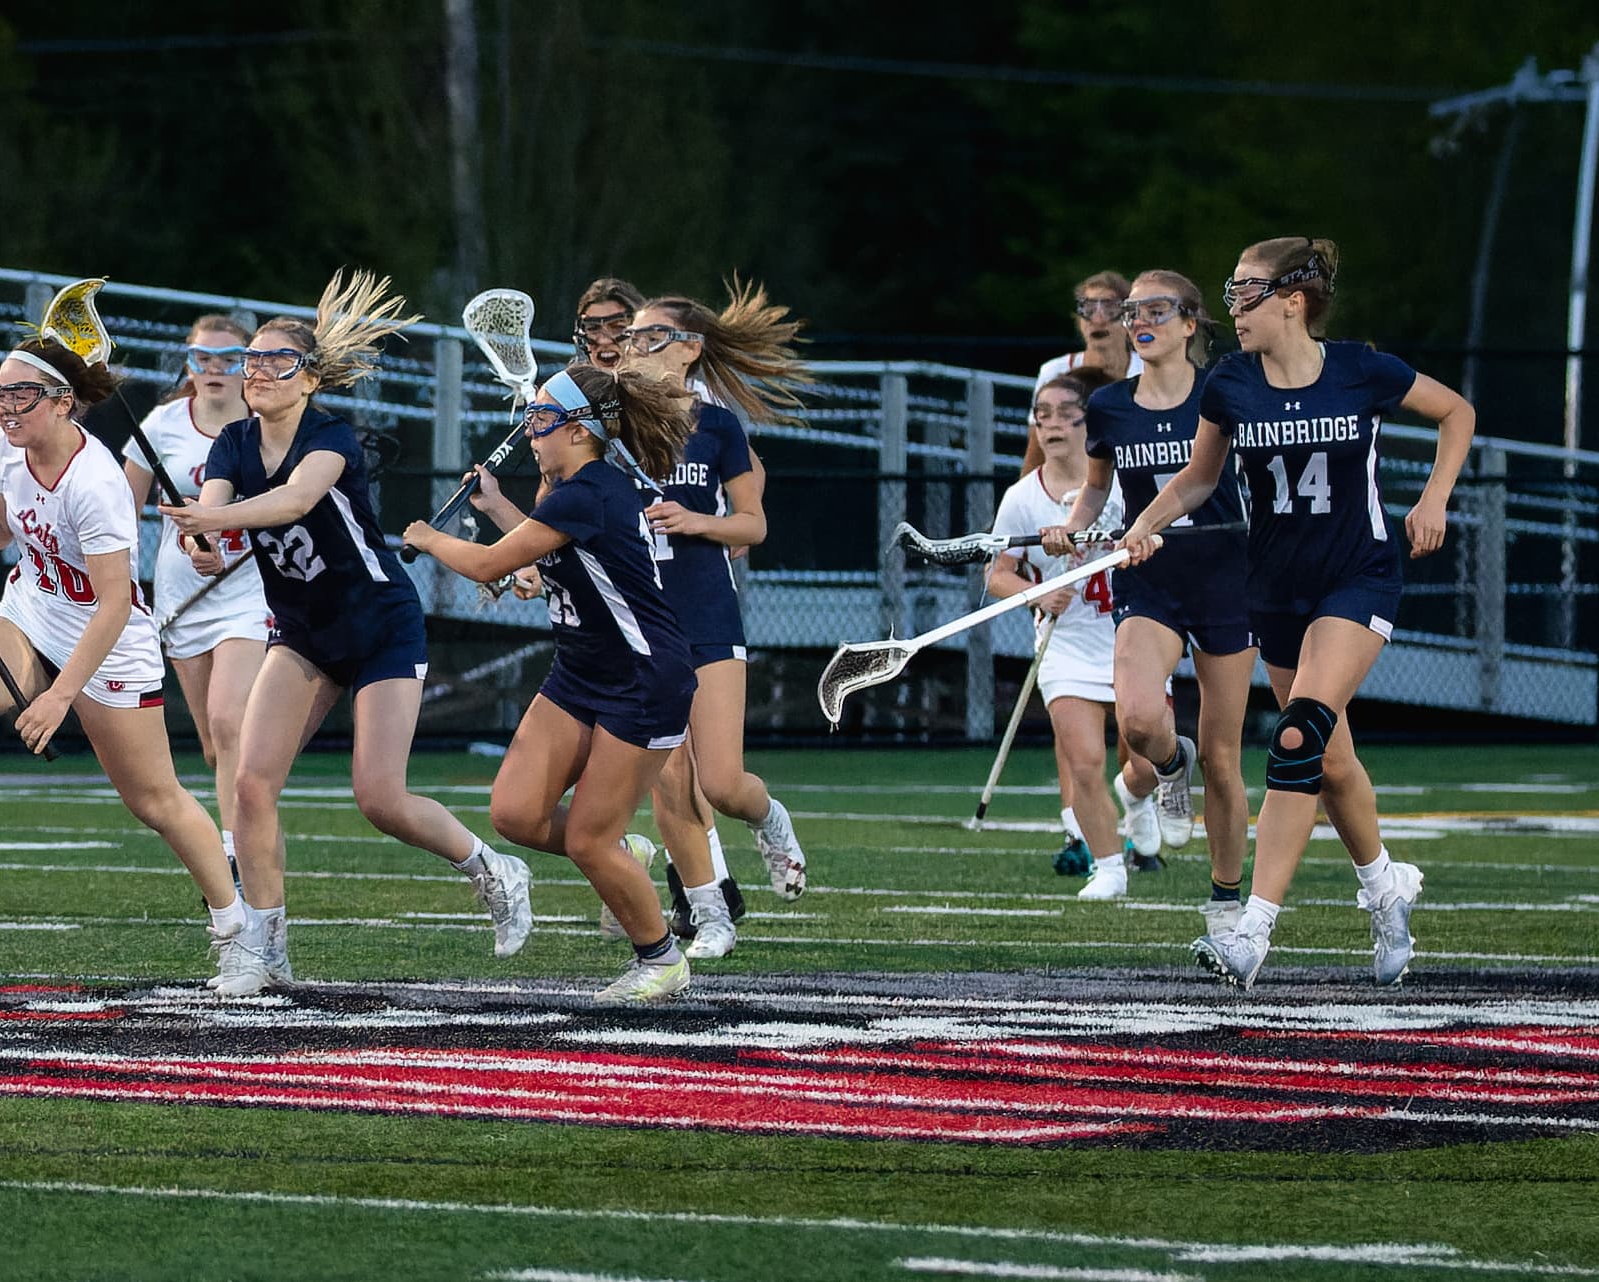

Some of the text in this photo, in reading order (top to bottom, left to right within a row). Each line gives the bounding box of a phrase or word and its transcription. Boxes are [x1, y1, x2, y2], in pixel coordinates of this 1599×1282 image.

[1238, 415, 1360, 447] BAINBRIDGE
[490, 441, 514, 467] STX
[1114, 440, 1195, 469] BAINBRI
[1266, 452, 1331, 514] 14
[17, 508, 59, 555] Cats
[1074, 526, 1112, 543] STX
[257, 525, 327, 582] 22
[25, 543, 98, 606] 10
